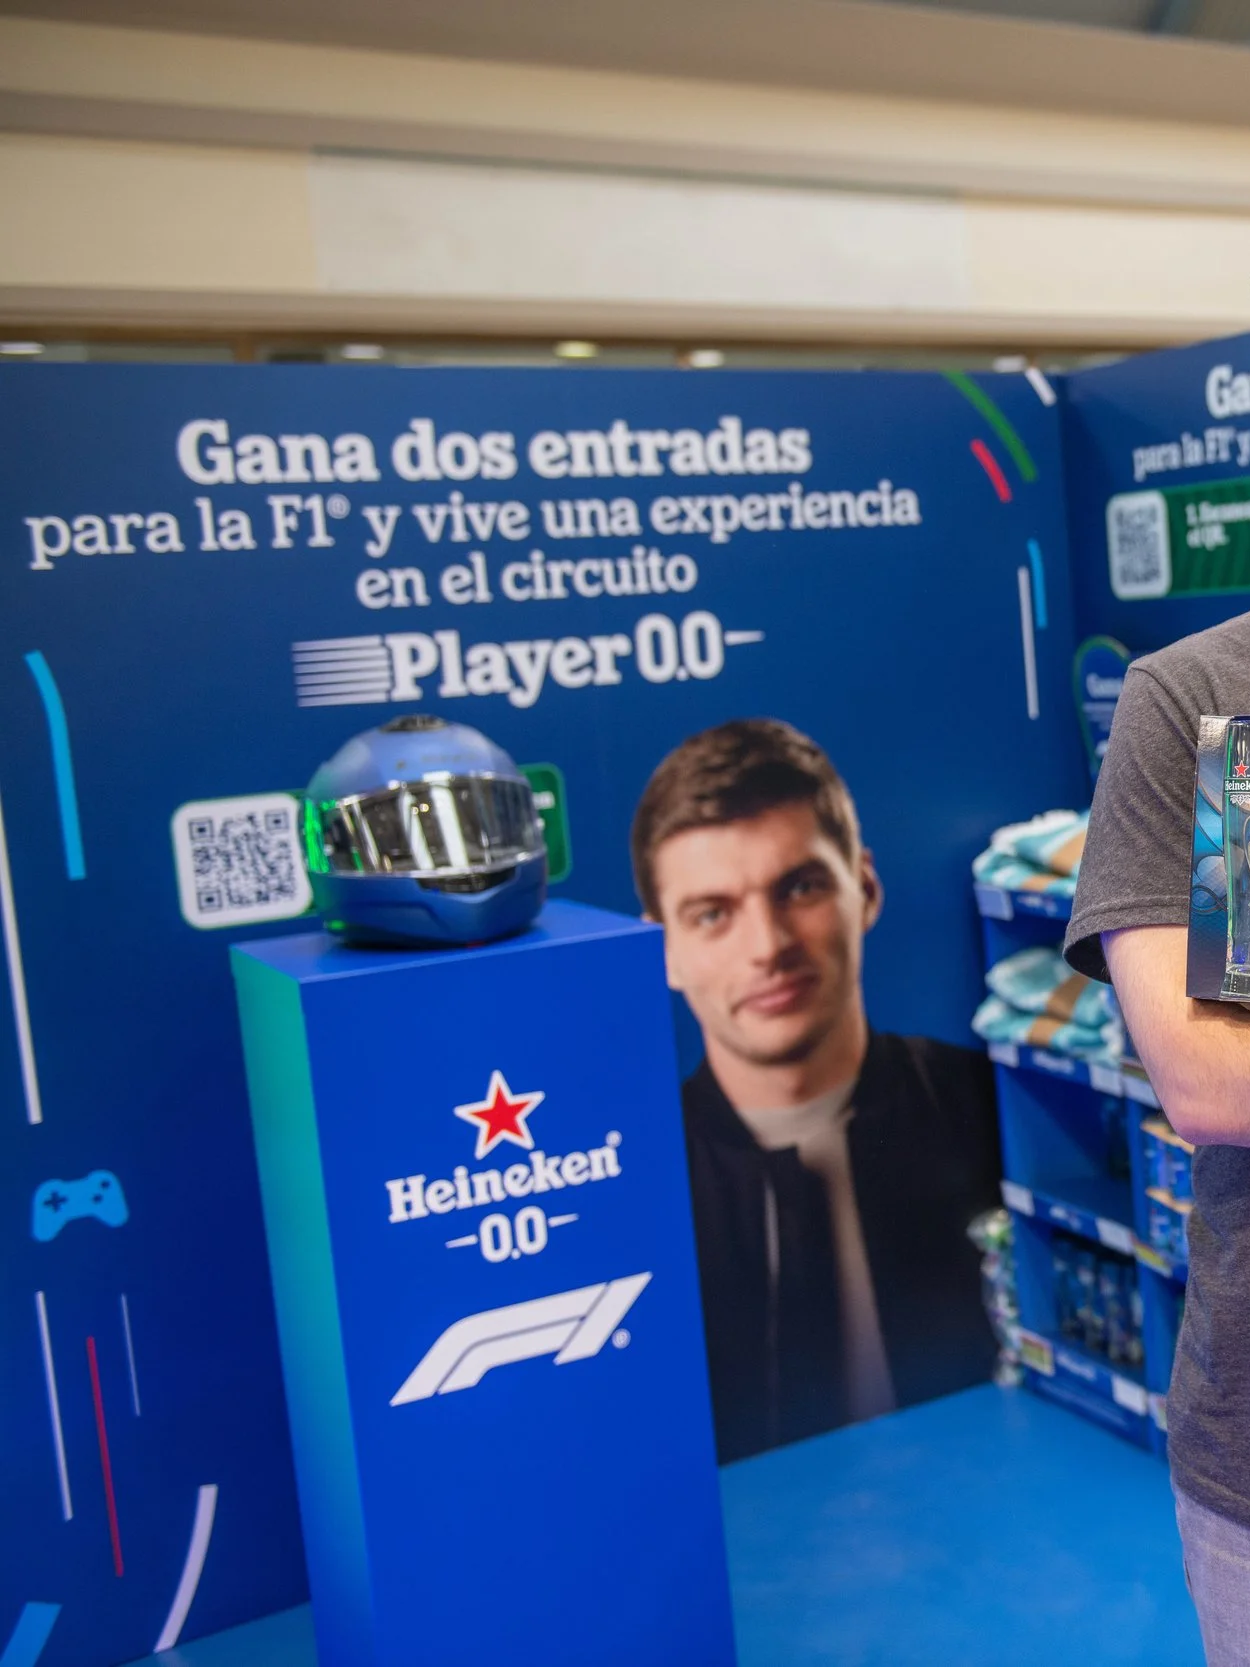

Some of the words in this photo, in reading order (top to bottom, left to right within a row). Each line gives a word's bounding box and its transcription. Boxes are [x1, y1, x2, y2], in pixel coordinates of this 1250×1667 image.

[177, 419, 381, 485] Gana
[392, 418, 518, 480] dos
[528, 416, 812, 478] entradas
[27, 510, 185, 569] para
[199, 498, 257, 552] la
[363, 501, 402, 557] y
[412, 491, 531, 545] vive
[543, 497, 641, 539] una
[650, 479, 923, 545] experiencia
[355, 567, 430, 610] en
[440, 552, 494, 605] el
[502, 543, 699, 599] circuito
[387, 619, 632, 709] Player
